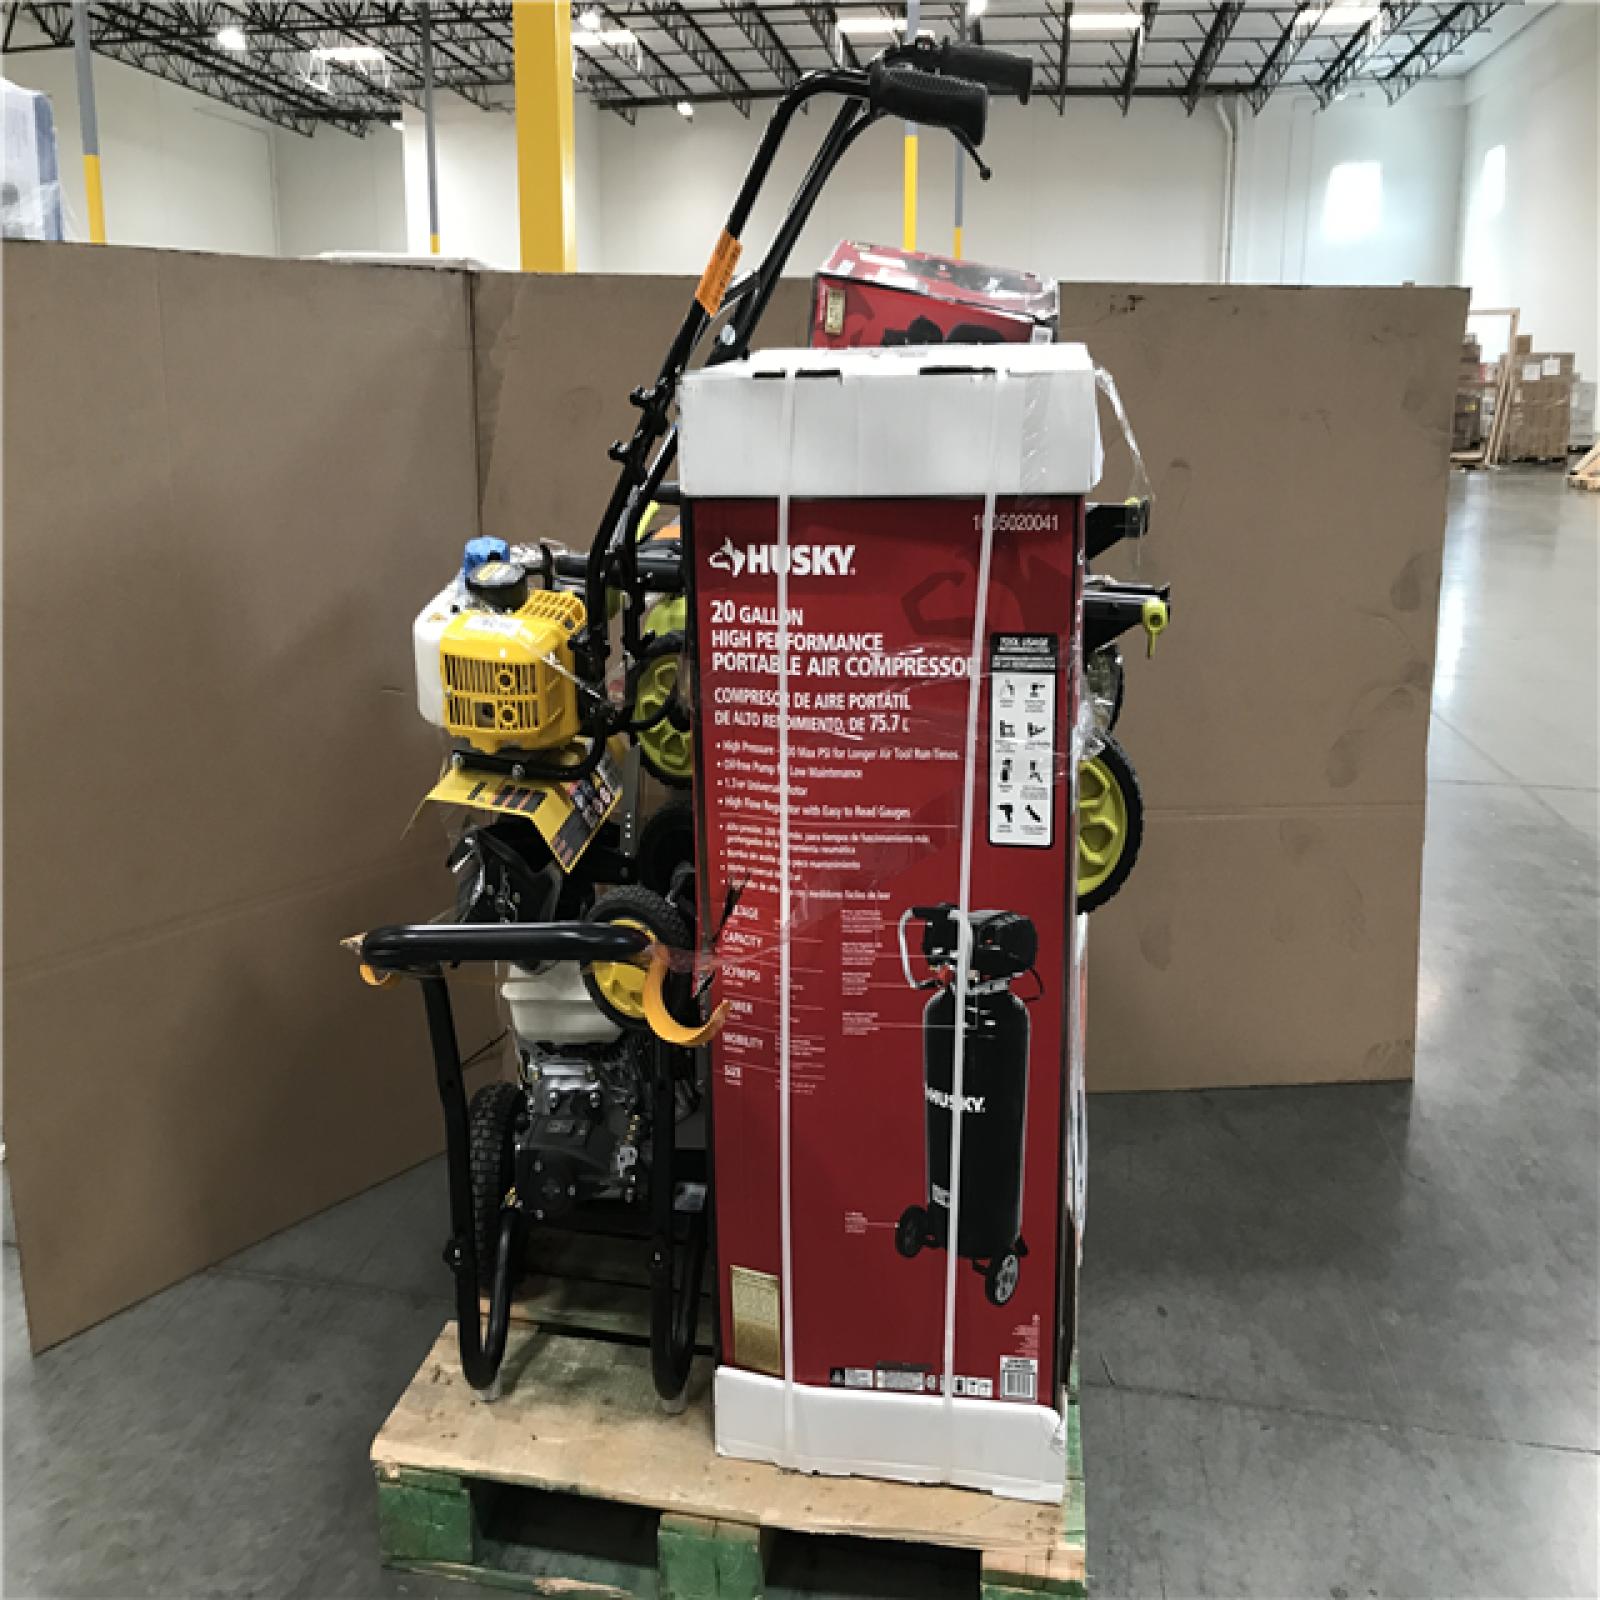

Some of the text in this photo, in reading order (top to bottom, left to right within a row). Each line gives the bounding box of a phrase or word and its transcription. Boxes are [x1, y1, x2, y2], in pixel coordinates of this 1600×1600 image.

[973, 513, 1059, 531] 105020041
[747, 544, 856, 576] HUSKY
[710, 599, 735, 623] 20
[711, 629, 884, 652] HIGH PEFORMANCE
[807, 656, 840, 676] AIR
[794, 691, 811, 709] DE
[814, 691, 846, 710] AIRE
[714, 709, 730, 726] DE
[733, 710, 760, 728] ALTO
[849, 716, 865, 733] DE
[869, 713, 900, 733] 75.7
[747, 780, 782, 793] Universa
[783, 785, 808, 796] otor
[728, 999, 754, 1015] WER
